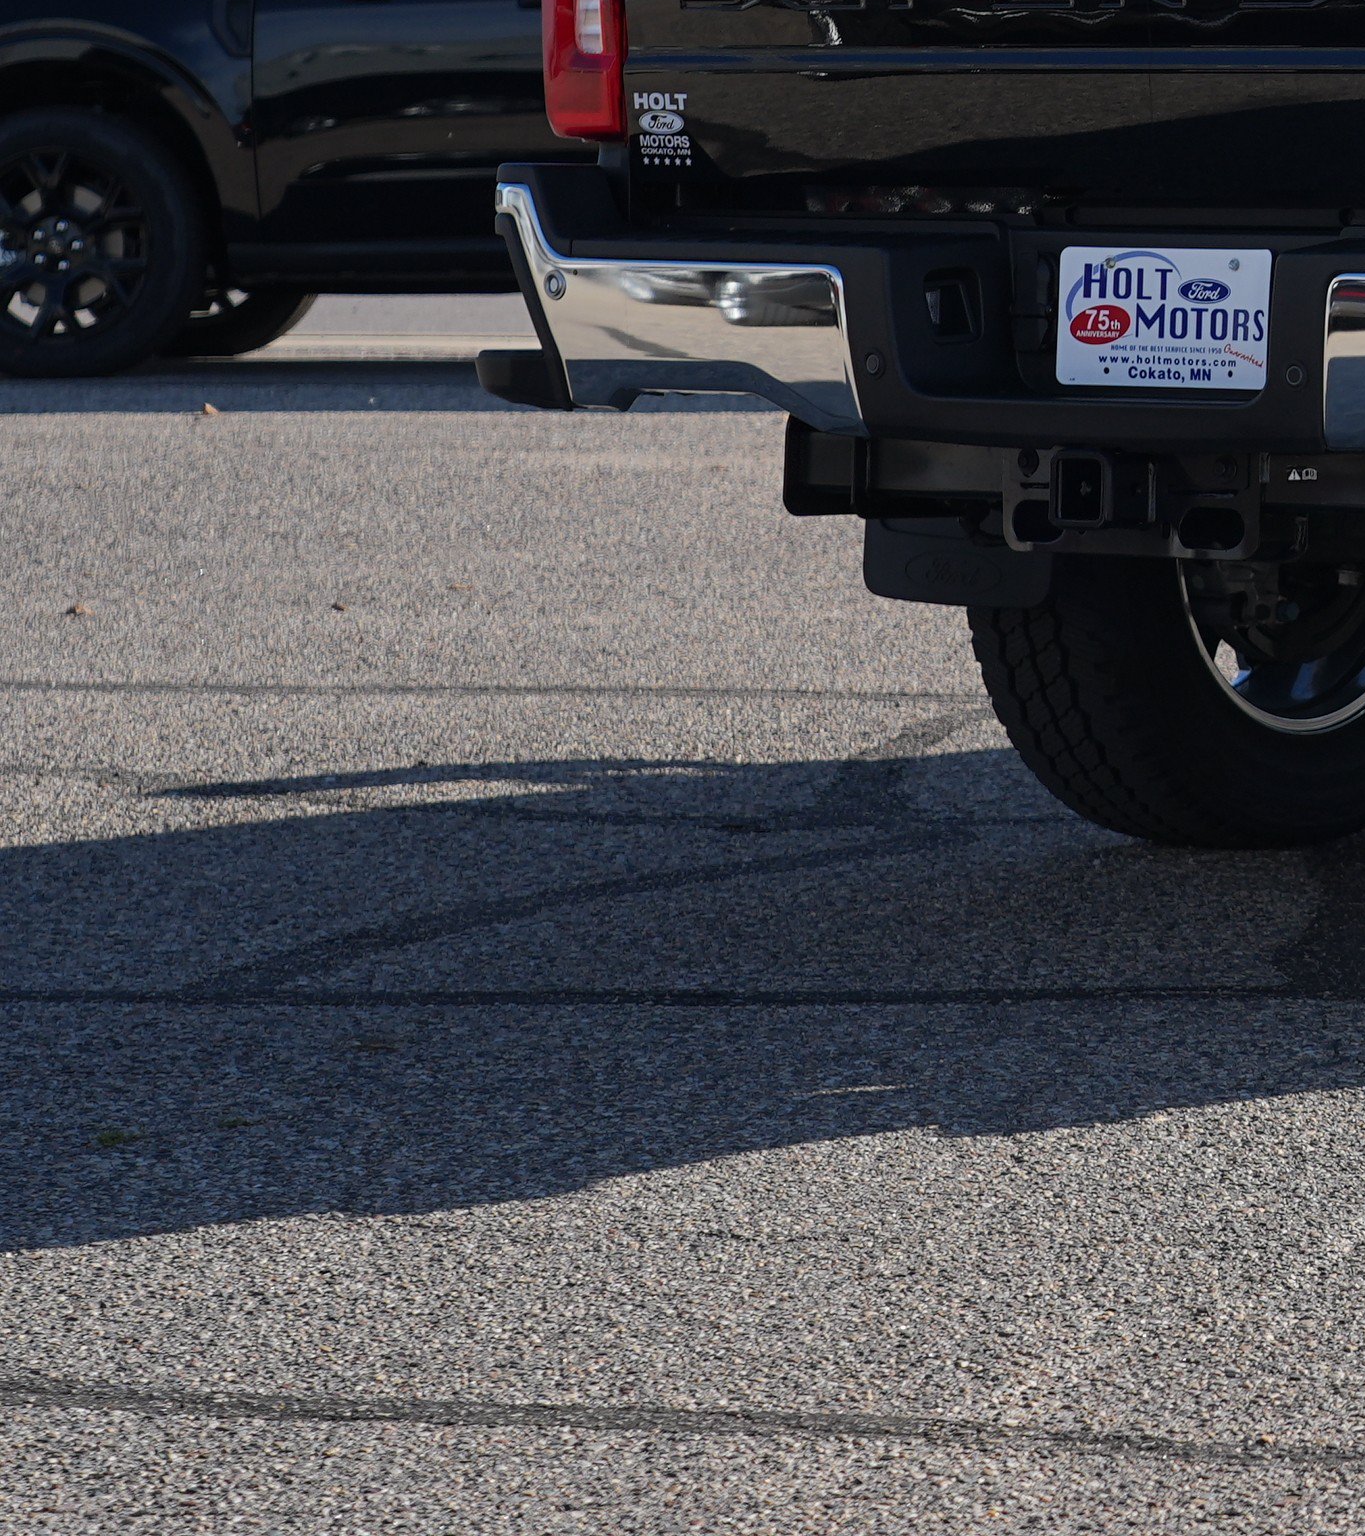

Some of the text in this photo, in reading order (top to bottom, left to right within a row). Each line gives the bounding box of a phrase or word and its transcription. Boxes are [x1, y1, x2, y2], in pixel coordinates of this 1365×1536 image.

[633, 92, 688, 111] HOLT
[648, 114, 675, 130] Ford
[639, 134, 691, 148] MOTORS
[641, 147, 692, 156] COKATO, MN
[1083, 263, 1173, 301] HOLT
[1187, 281, 1221, 301] Ford
[1085, 309, 1121, 331] 75th
[1135, 302, 1265, 342] MOTORS
[1075, 329, 1121, 339] ANNIVERSARY
[1110, 344, 1128, 352] HOME
[1150, 345, 1164, 353] BEST
[1165, 346, 1188, 354] SERVICE
[1189, 346, 1206, 354] SINCE
[1208, 347, 1222, 355] 1950
[1223, 343, 1264, 368] Guaranteed
[1098, 354, 1237, 368] www.holtmotors.com
[1128, 366, 1212, 383] Cokato, MN
